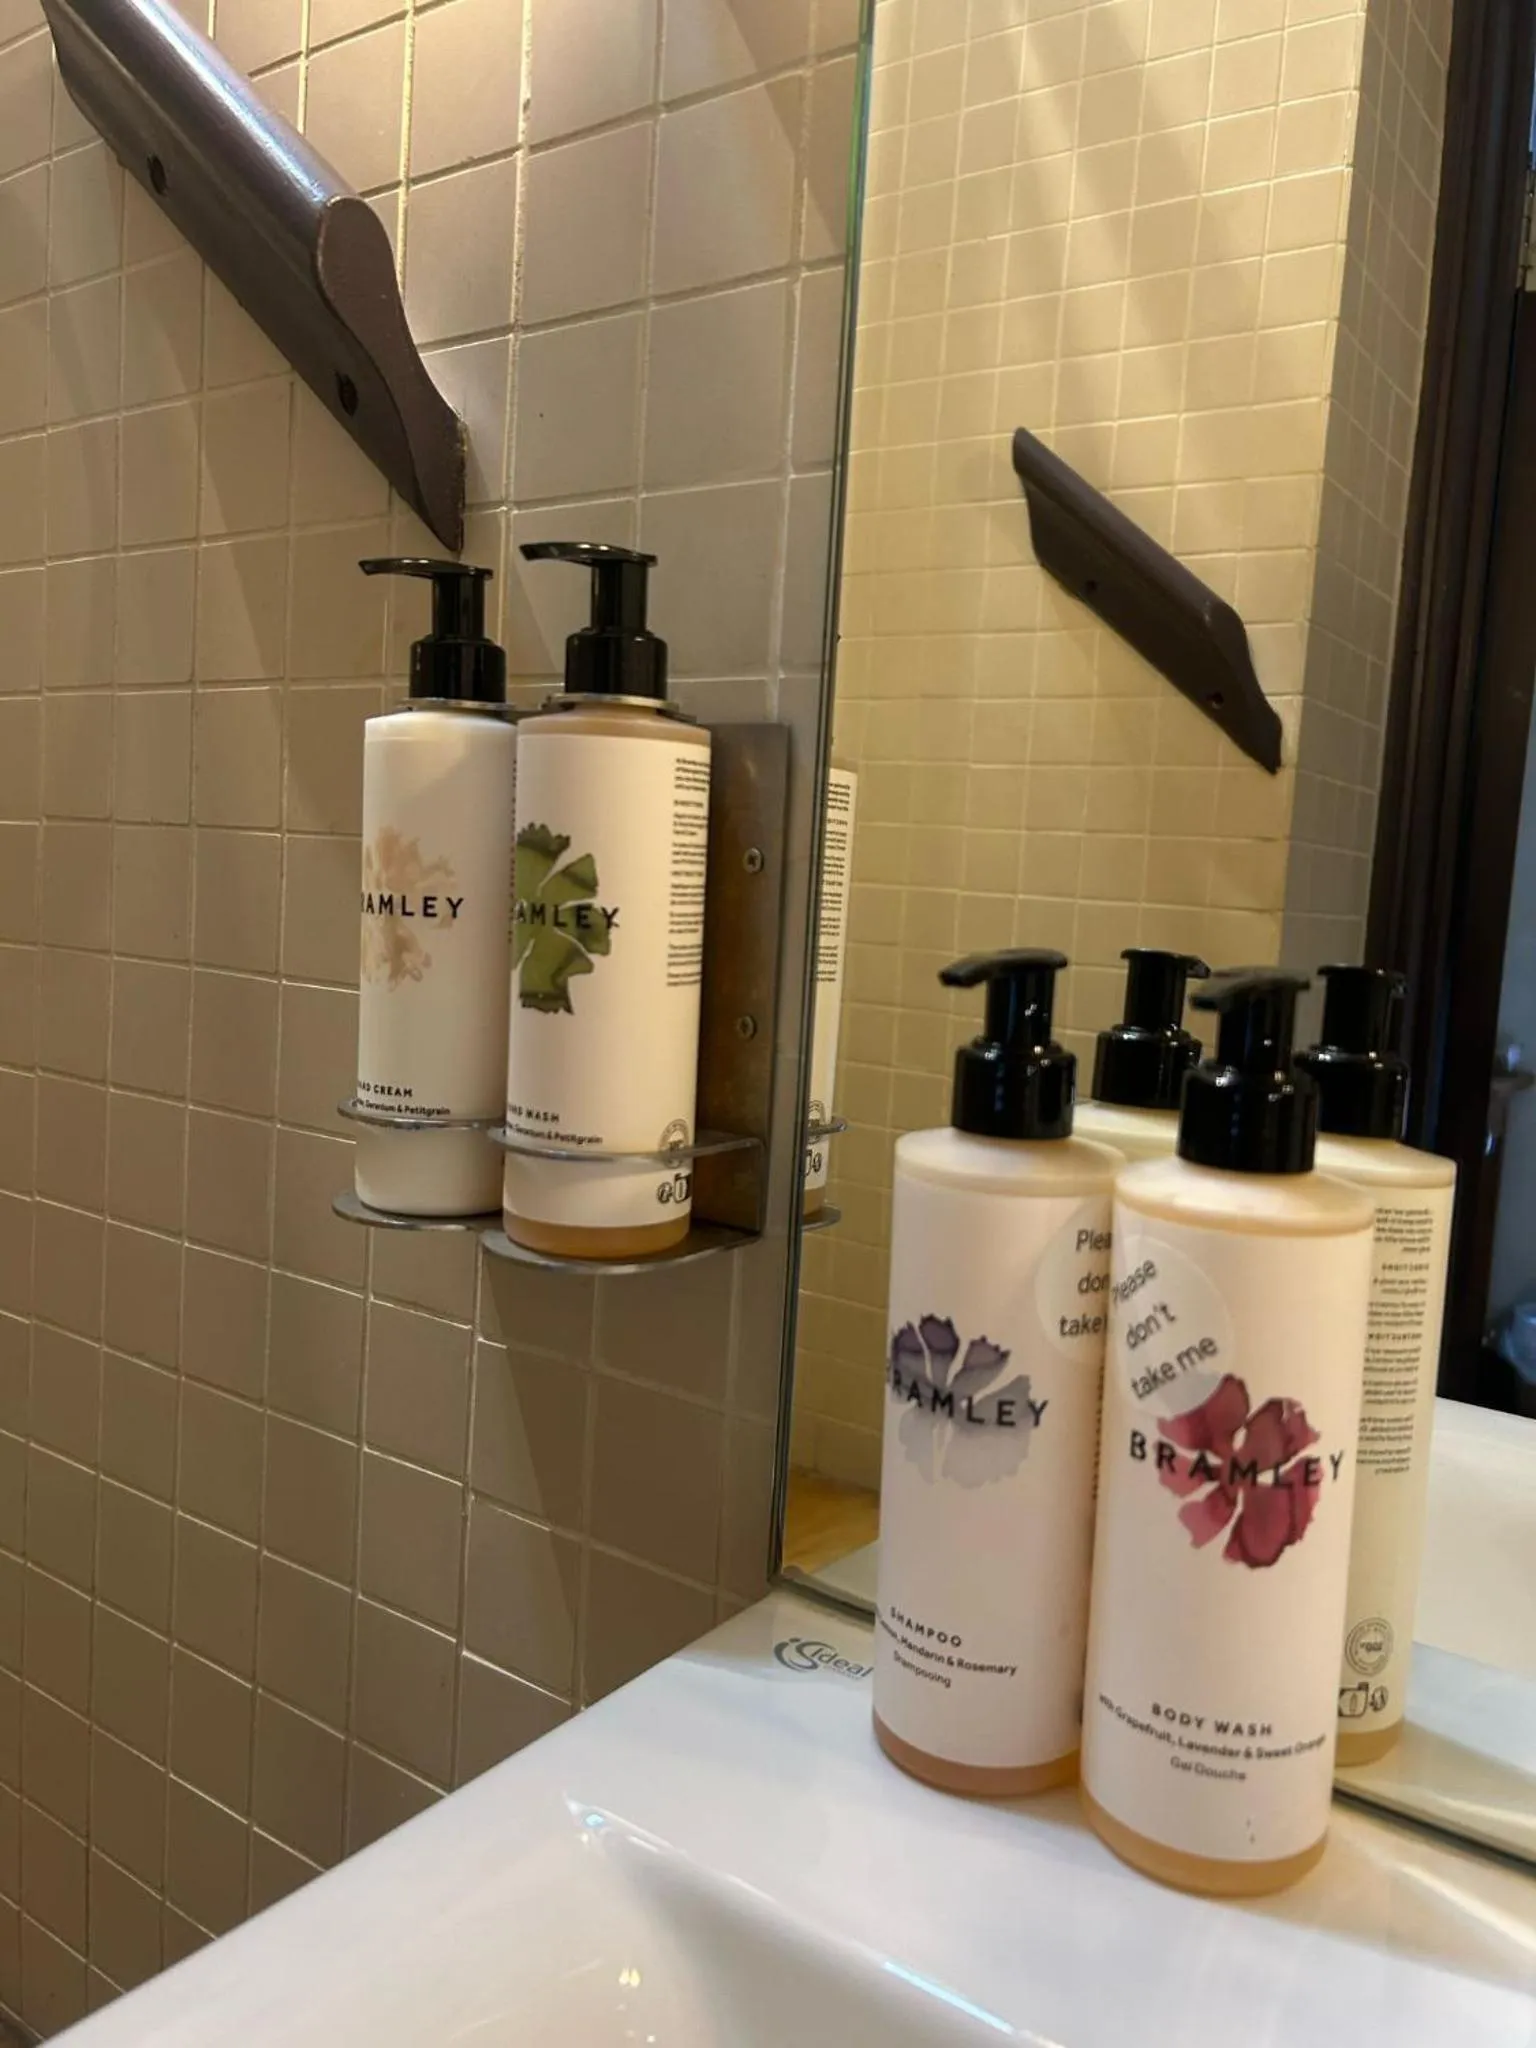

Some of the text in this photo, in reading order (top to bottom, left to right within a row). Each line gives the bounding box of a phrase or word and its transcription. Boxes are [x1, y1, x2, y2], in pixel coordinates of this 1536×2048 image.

[516, 902, 619, 929] AMLEY
[373, 1084, 413, 1098] CREAM
[526, 1109, 560, 1122] WASH
[1076, 1229, 1112, 1251] Plea
[1126, 1303, 1176, 1350] don't
[1131, 1337, 1219, 1399] take me
[886, 1363, 1049, 1426] RAMLEY
[1130, 1430, 1345, 1488] BRAMLEY
[890, 1606, 963, 1648] SHAMPOO
[810, 1646, 875, 1678] Ideal
[900, 1634, 1018, 1678] Mandarin & Rosemary
[1151, 1702, 1273, 1737] BODY WASH
[1177, 1735, 1241, 1759] Lavender
[1243, 1746, 1253, 1760] &
[1194, 1763, 1247, 1782] Douche
